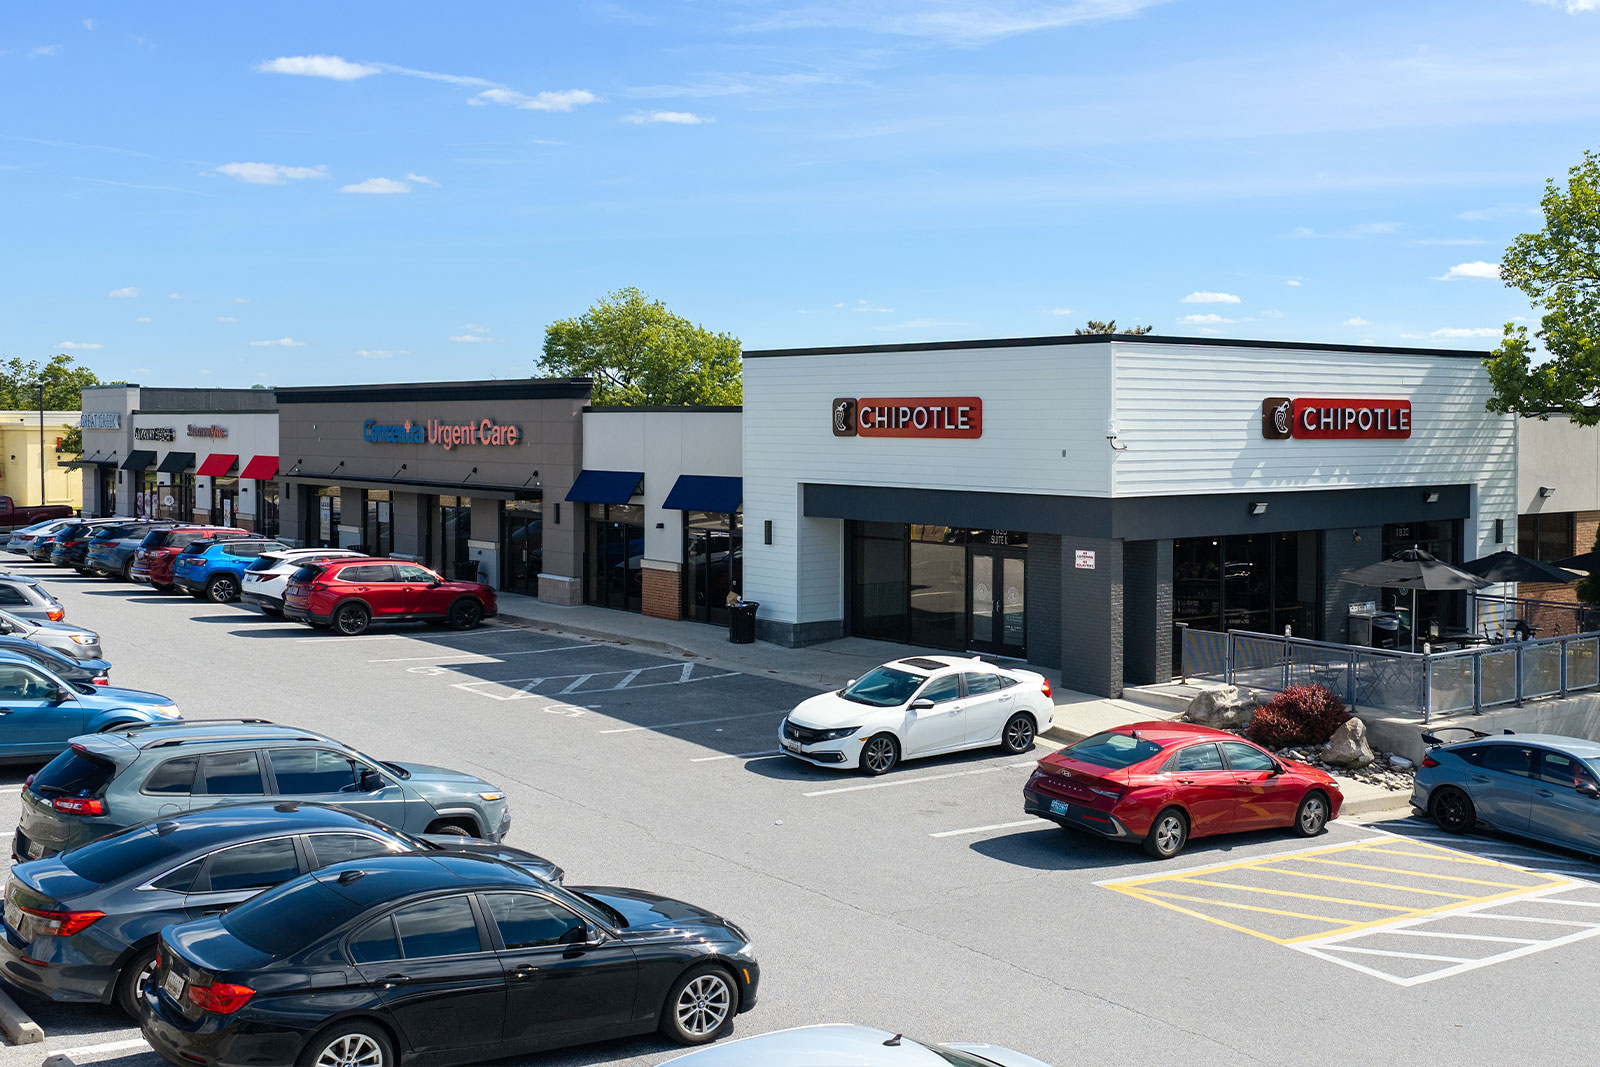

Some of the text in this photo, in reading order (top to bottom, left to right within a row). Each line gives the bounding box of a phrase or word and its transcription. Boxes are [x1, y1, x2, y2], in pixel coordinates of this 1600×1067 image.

[859, 406, 970, 430] CHIPOTLE
[1303, 406, 1410, 431] CHIPOTLE
[363, 418, 518, 450] Concentra Urgent Care
[1395, 527, 1410, 537] 1830
